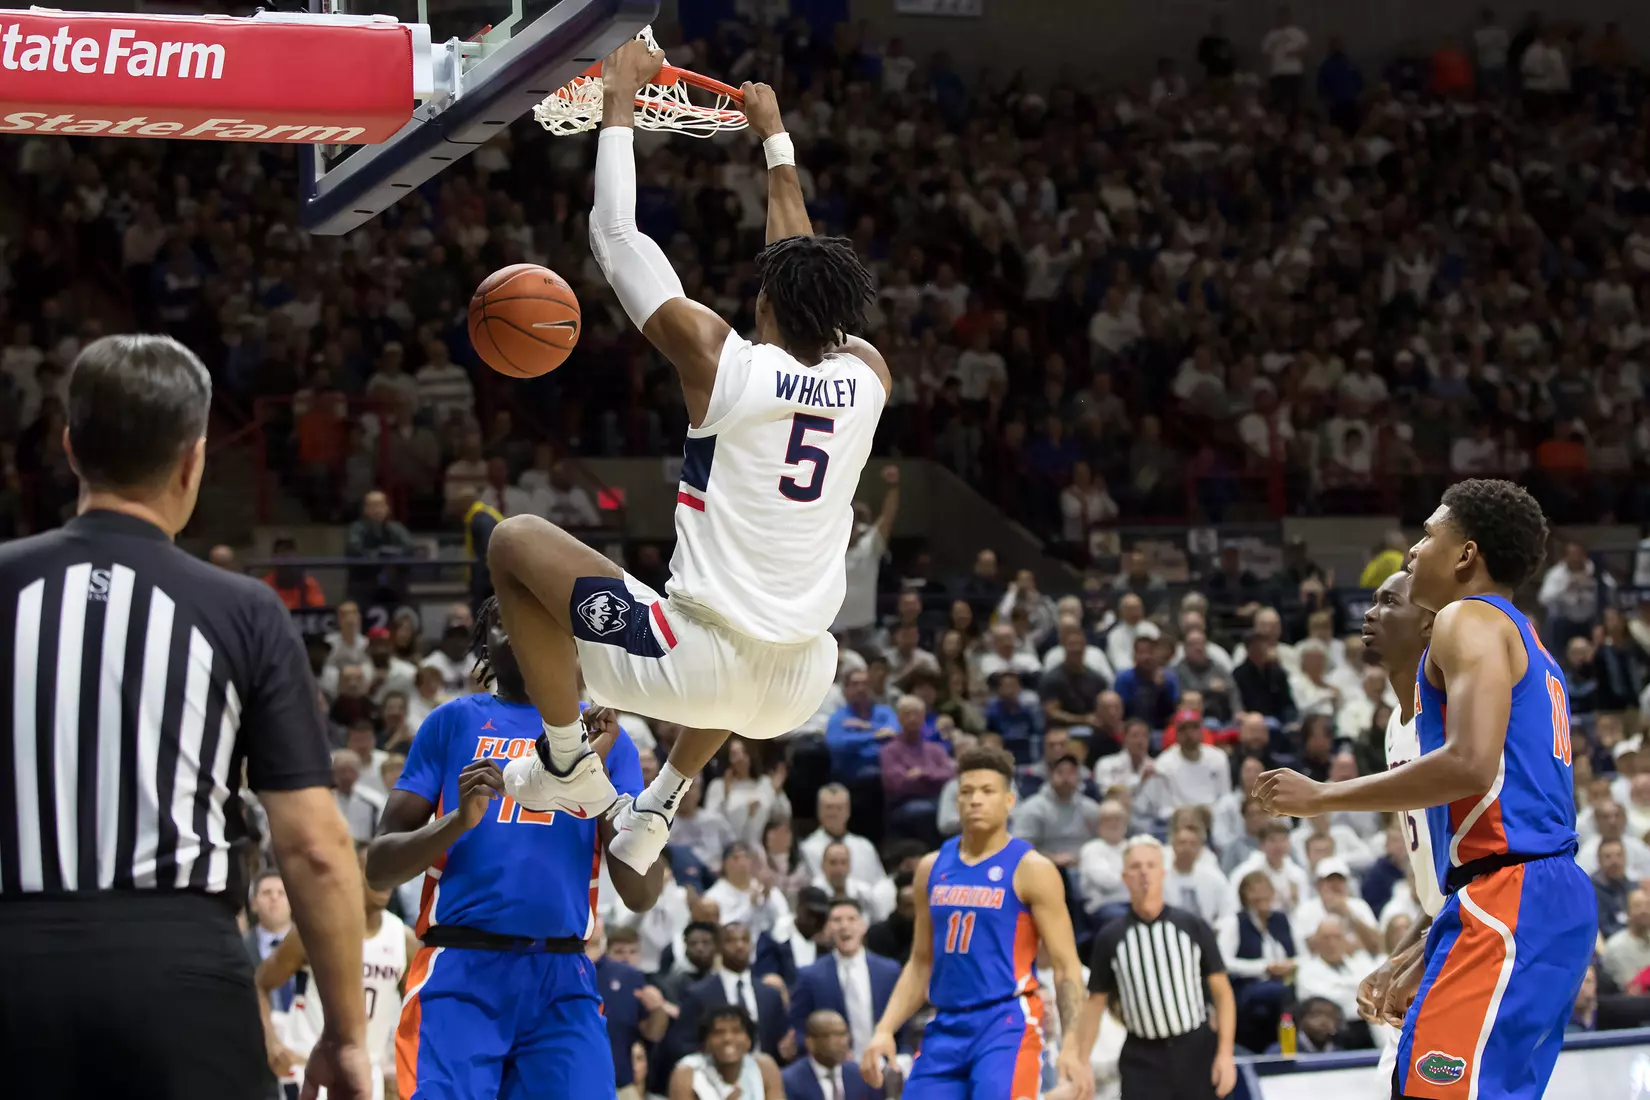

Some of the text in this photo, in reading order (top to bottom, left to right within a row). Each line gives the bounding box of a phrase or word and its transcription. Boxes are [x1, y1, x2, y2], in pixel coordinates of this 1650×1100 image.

[0, 23, 100, 74] tate
[776, 370, 856, 408] WHALEY
[778, 411, 835, 503] 5
[1545, 669, 1572, 767] 10
[929, 884, 1006, 910] FLORIDA
[944, 910, 977, 955] 11
